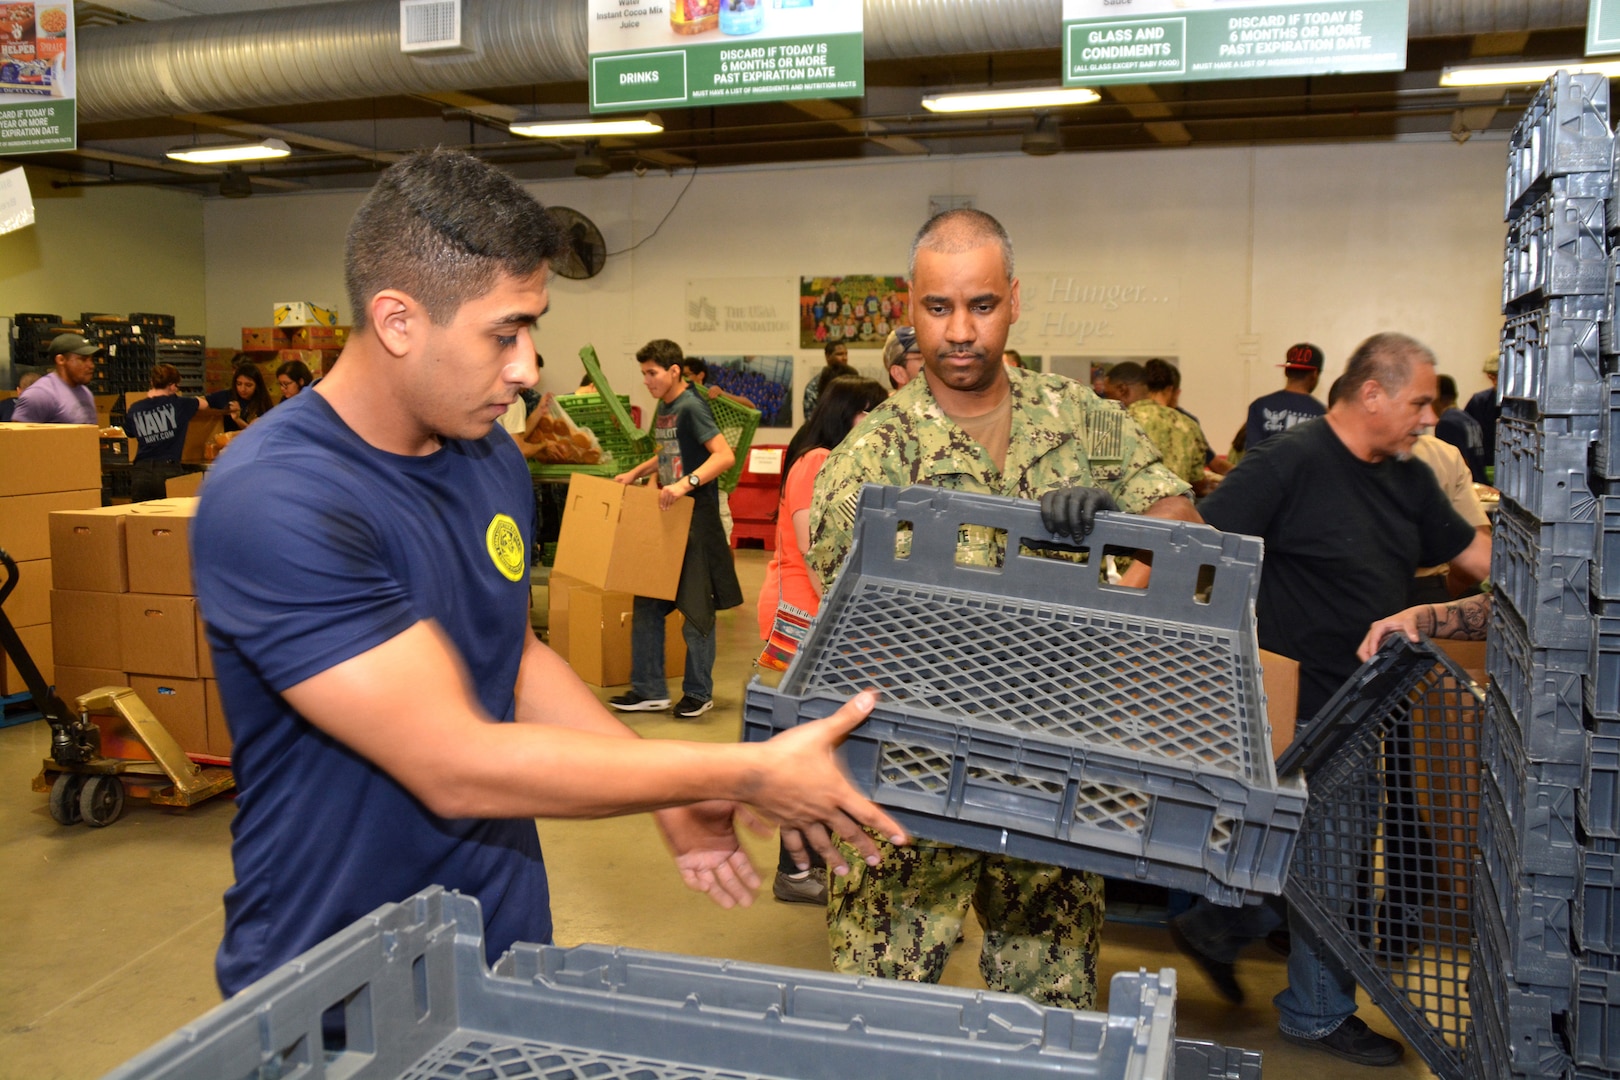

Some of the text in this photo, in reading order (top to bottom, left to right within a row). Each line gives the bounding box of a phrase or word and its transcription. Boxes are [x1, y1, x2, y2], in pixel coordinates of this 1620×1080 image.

[596, 6, 663, 20] Instant Cocoa Mix
[1229, 9, 1364, 30] DISCARD IF TODAY IS
[620, 20, 640, 29] Juice
[1088, 26, 1165, 43] GLASS AND
[1230, 23, 1362, 42] 6 MONTHS OR MORE
[1, 44, 35, 55] HELPER
[720, 43, 828, 61] DISCARD IF TODAY IS
[1082, 42, 1172, 60] CONDIMENTS
[1219, 35, 1372, 56] PAST EXPIRATION DATE
[721, 55, 827, 72] 6 MONTHS OR MORE
[1074, 58, 1180, 73] (ALL GLASS EXCEPT BABY FOOD)
[1192, 63, 1213, 71] MUST
[1214, 61, 1233, 69] HAVE
[1240, 60, 1256, 68] LIST
[619, 70, 660, 85] DRINKS
[714, 66, 836, 85] PAST EXPIRATION DATE
[709, 88, 724, 96] HAVE
[730, 87, 743, 95] LIST
[744, 86, 752, 94] OF
[752, 85, 790, 94] INGREDIENTS
[791, 83, 803, 91] AND
[804, 82, 836, 90] NUTRITION
[837, 80, 857, 88] FACTS
[17, 110, 24, 119] IF
[24, 108, 46, 118] TODAY
[47, 107, 55, 117] IS
[0, 117, 48, 129] YEAR OR MORE
[2, 125, 59, 138] EXPIRATION DATE
[724, 305, 745, 318] THE
[689, 321, 717, 332] USAA
[1038, 312, 1115, 346] Hope.
[133, 403, 177, 438] NAVY
[144, 430, 175, 444] NAVY.COM
